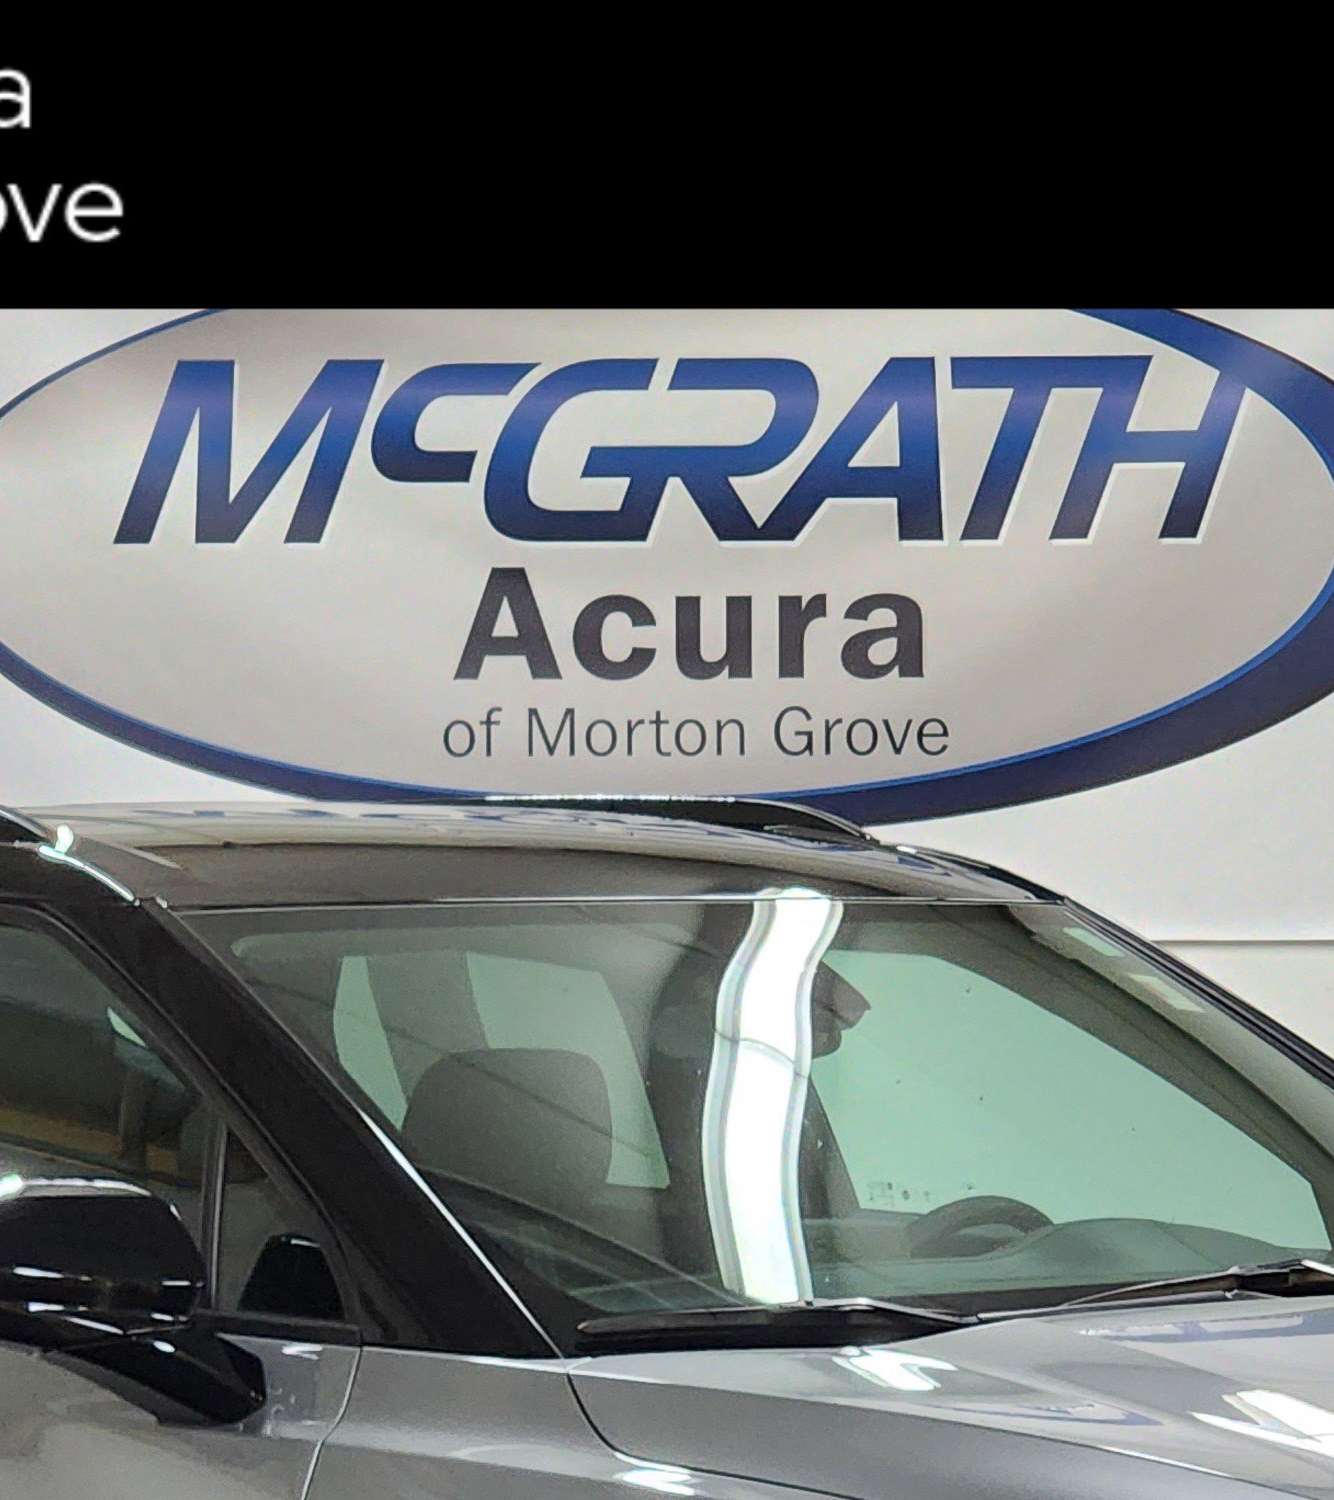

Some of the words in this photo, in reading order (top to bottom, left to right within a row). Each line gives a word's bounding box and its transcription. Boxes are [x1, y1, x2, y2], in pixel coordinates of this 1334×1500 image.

[453, 567, 925, 681] Acura
[442, 706, 503, 758] of
[527, 707, 746, 758] Morton
[772, 706, 951, 758] Grove
